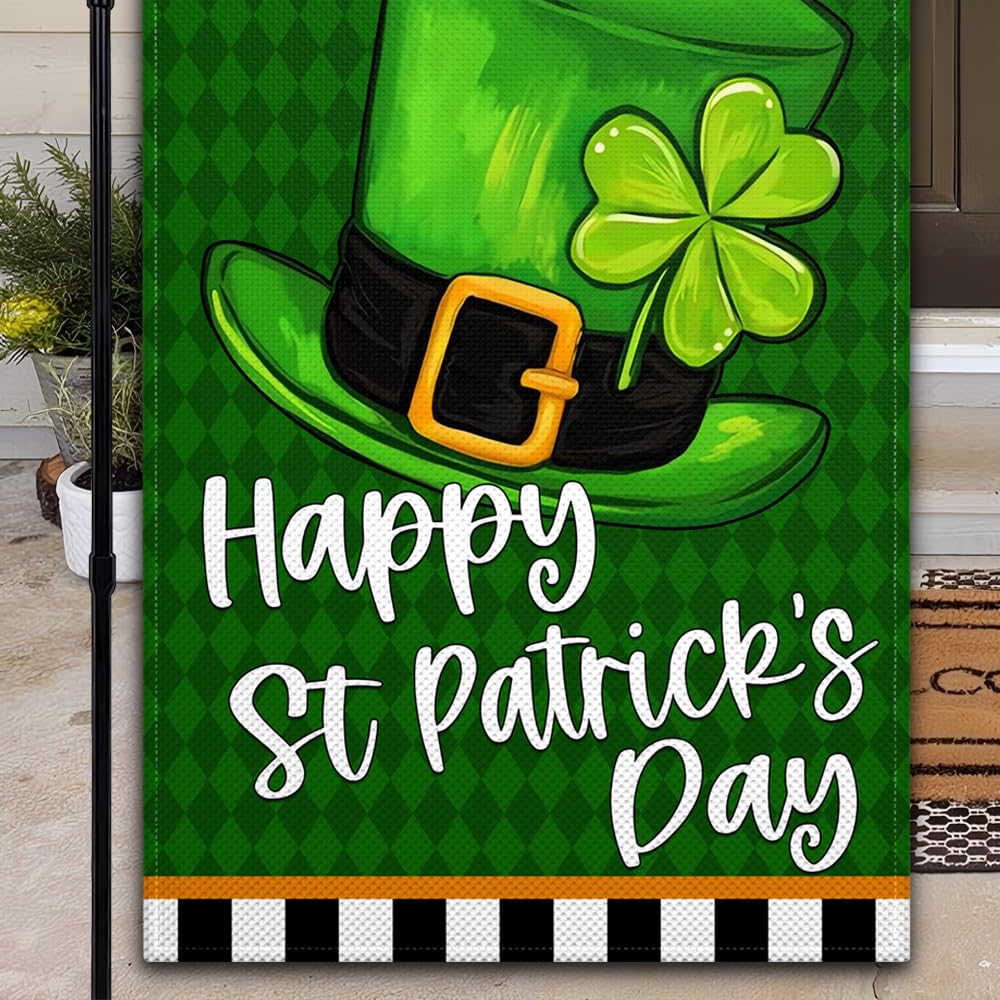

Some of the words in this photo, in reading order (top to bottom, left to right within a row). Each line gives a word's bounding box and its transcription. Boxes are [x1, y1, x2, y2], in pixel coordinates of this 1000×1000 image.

[203, 475, 597, 623] Happy
[229, 664, 383, 800] St
[413, 592, 879, 775] Patrick's
[611, 737, 859, 873] Day
